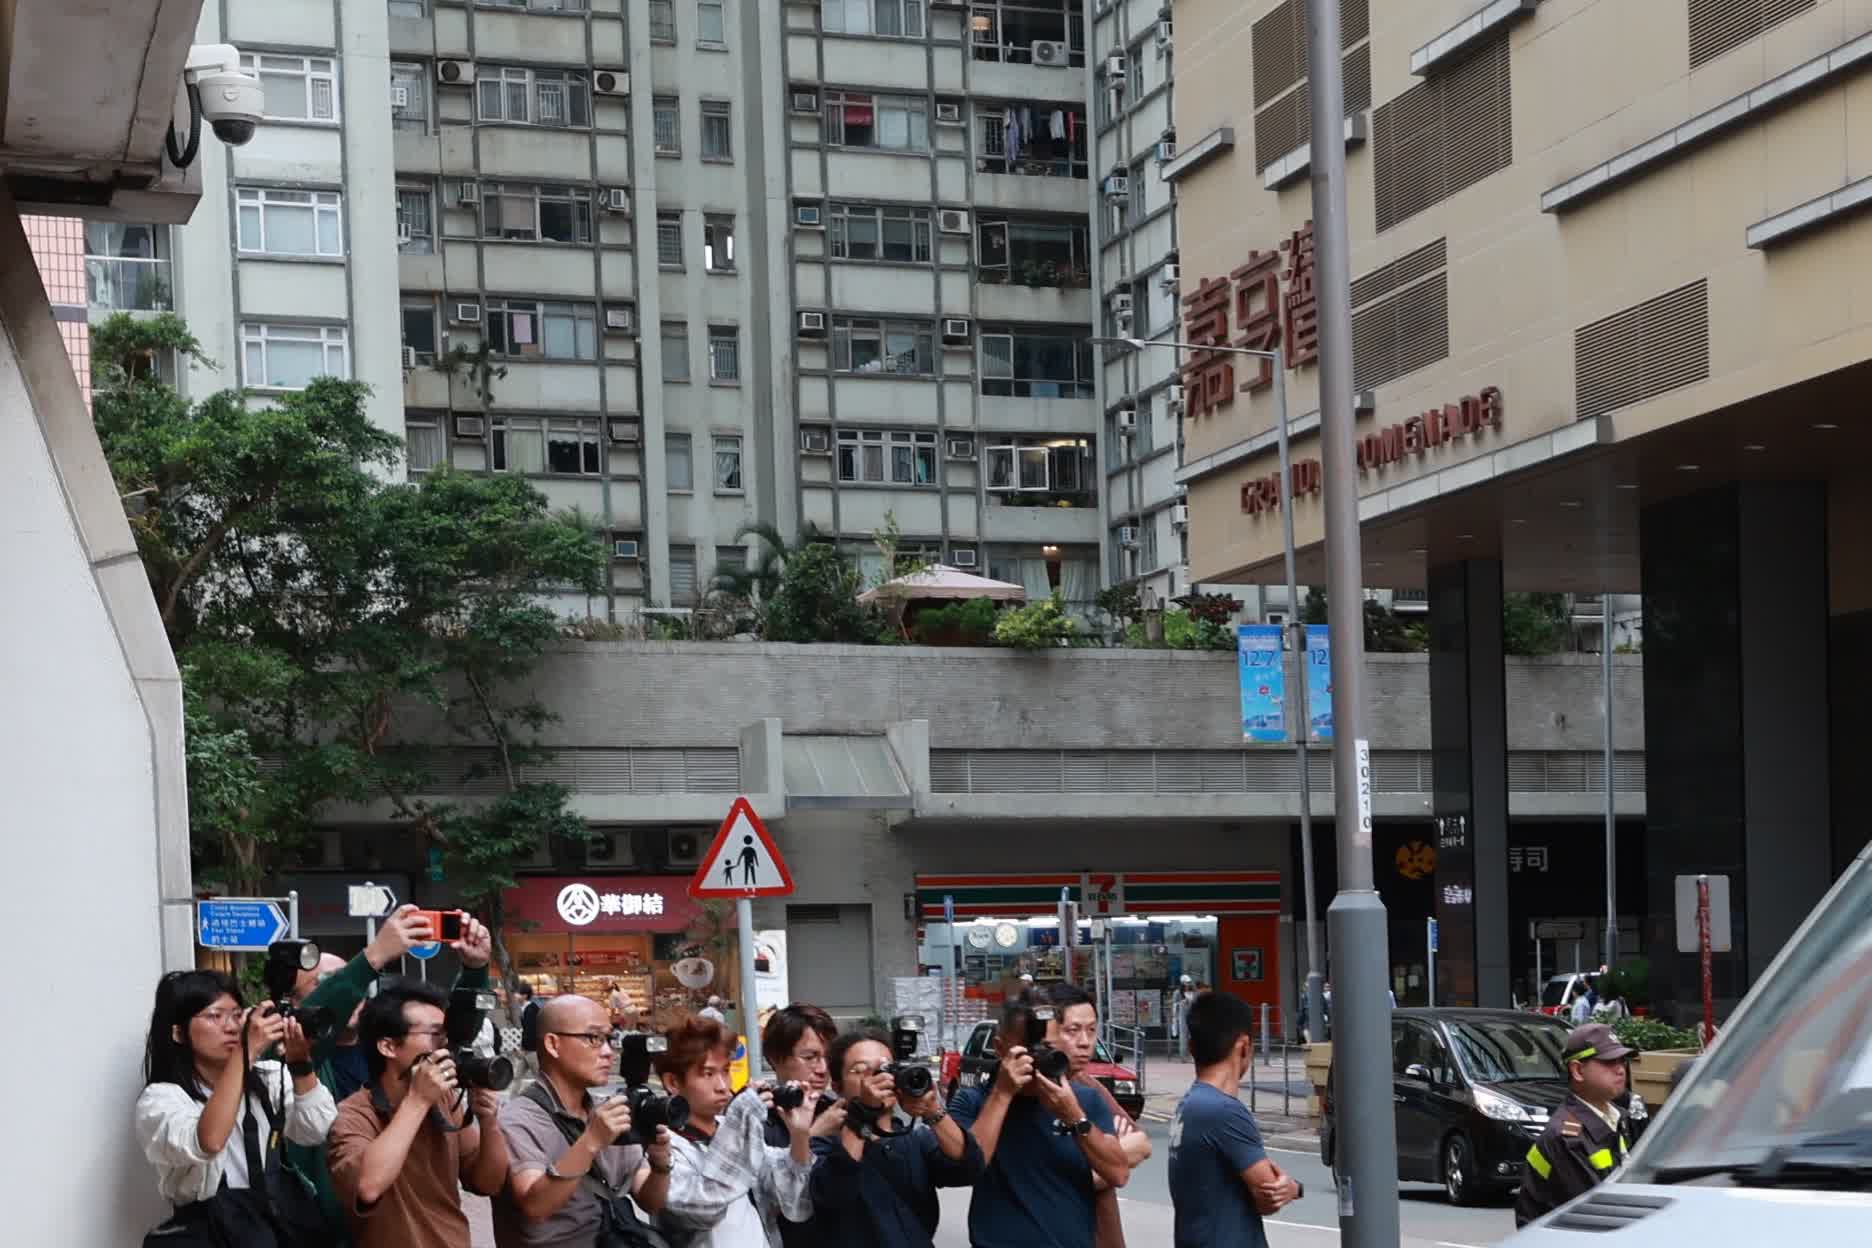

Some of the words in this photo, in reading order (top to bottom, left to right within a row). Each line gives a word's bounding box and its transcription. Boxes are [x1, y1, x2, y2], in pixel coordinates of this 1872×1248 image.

[1243, 650, 1275, 666] 127
[1311, 649, 1329, 665] 12
[1360, 749, 1371, 829] 30210
